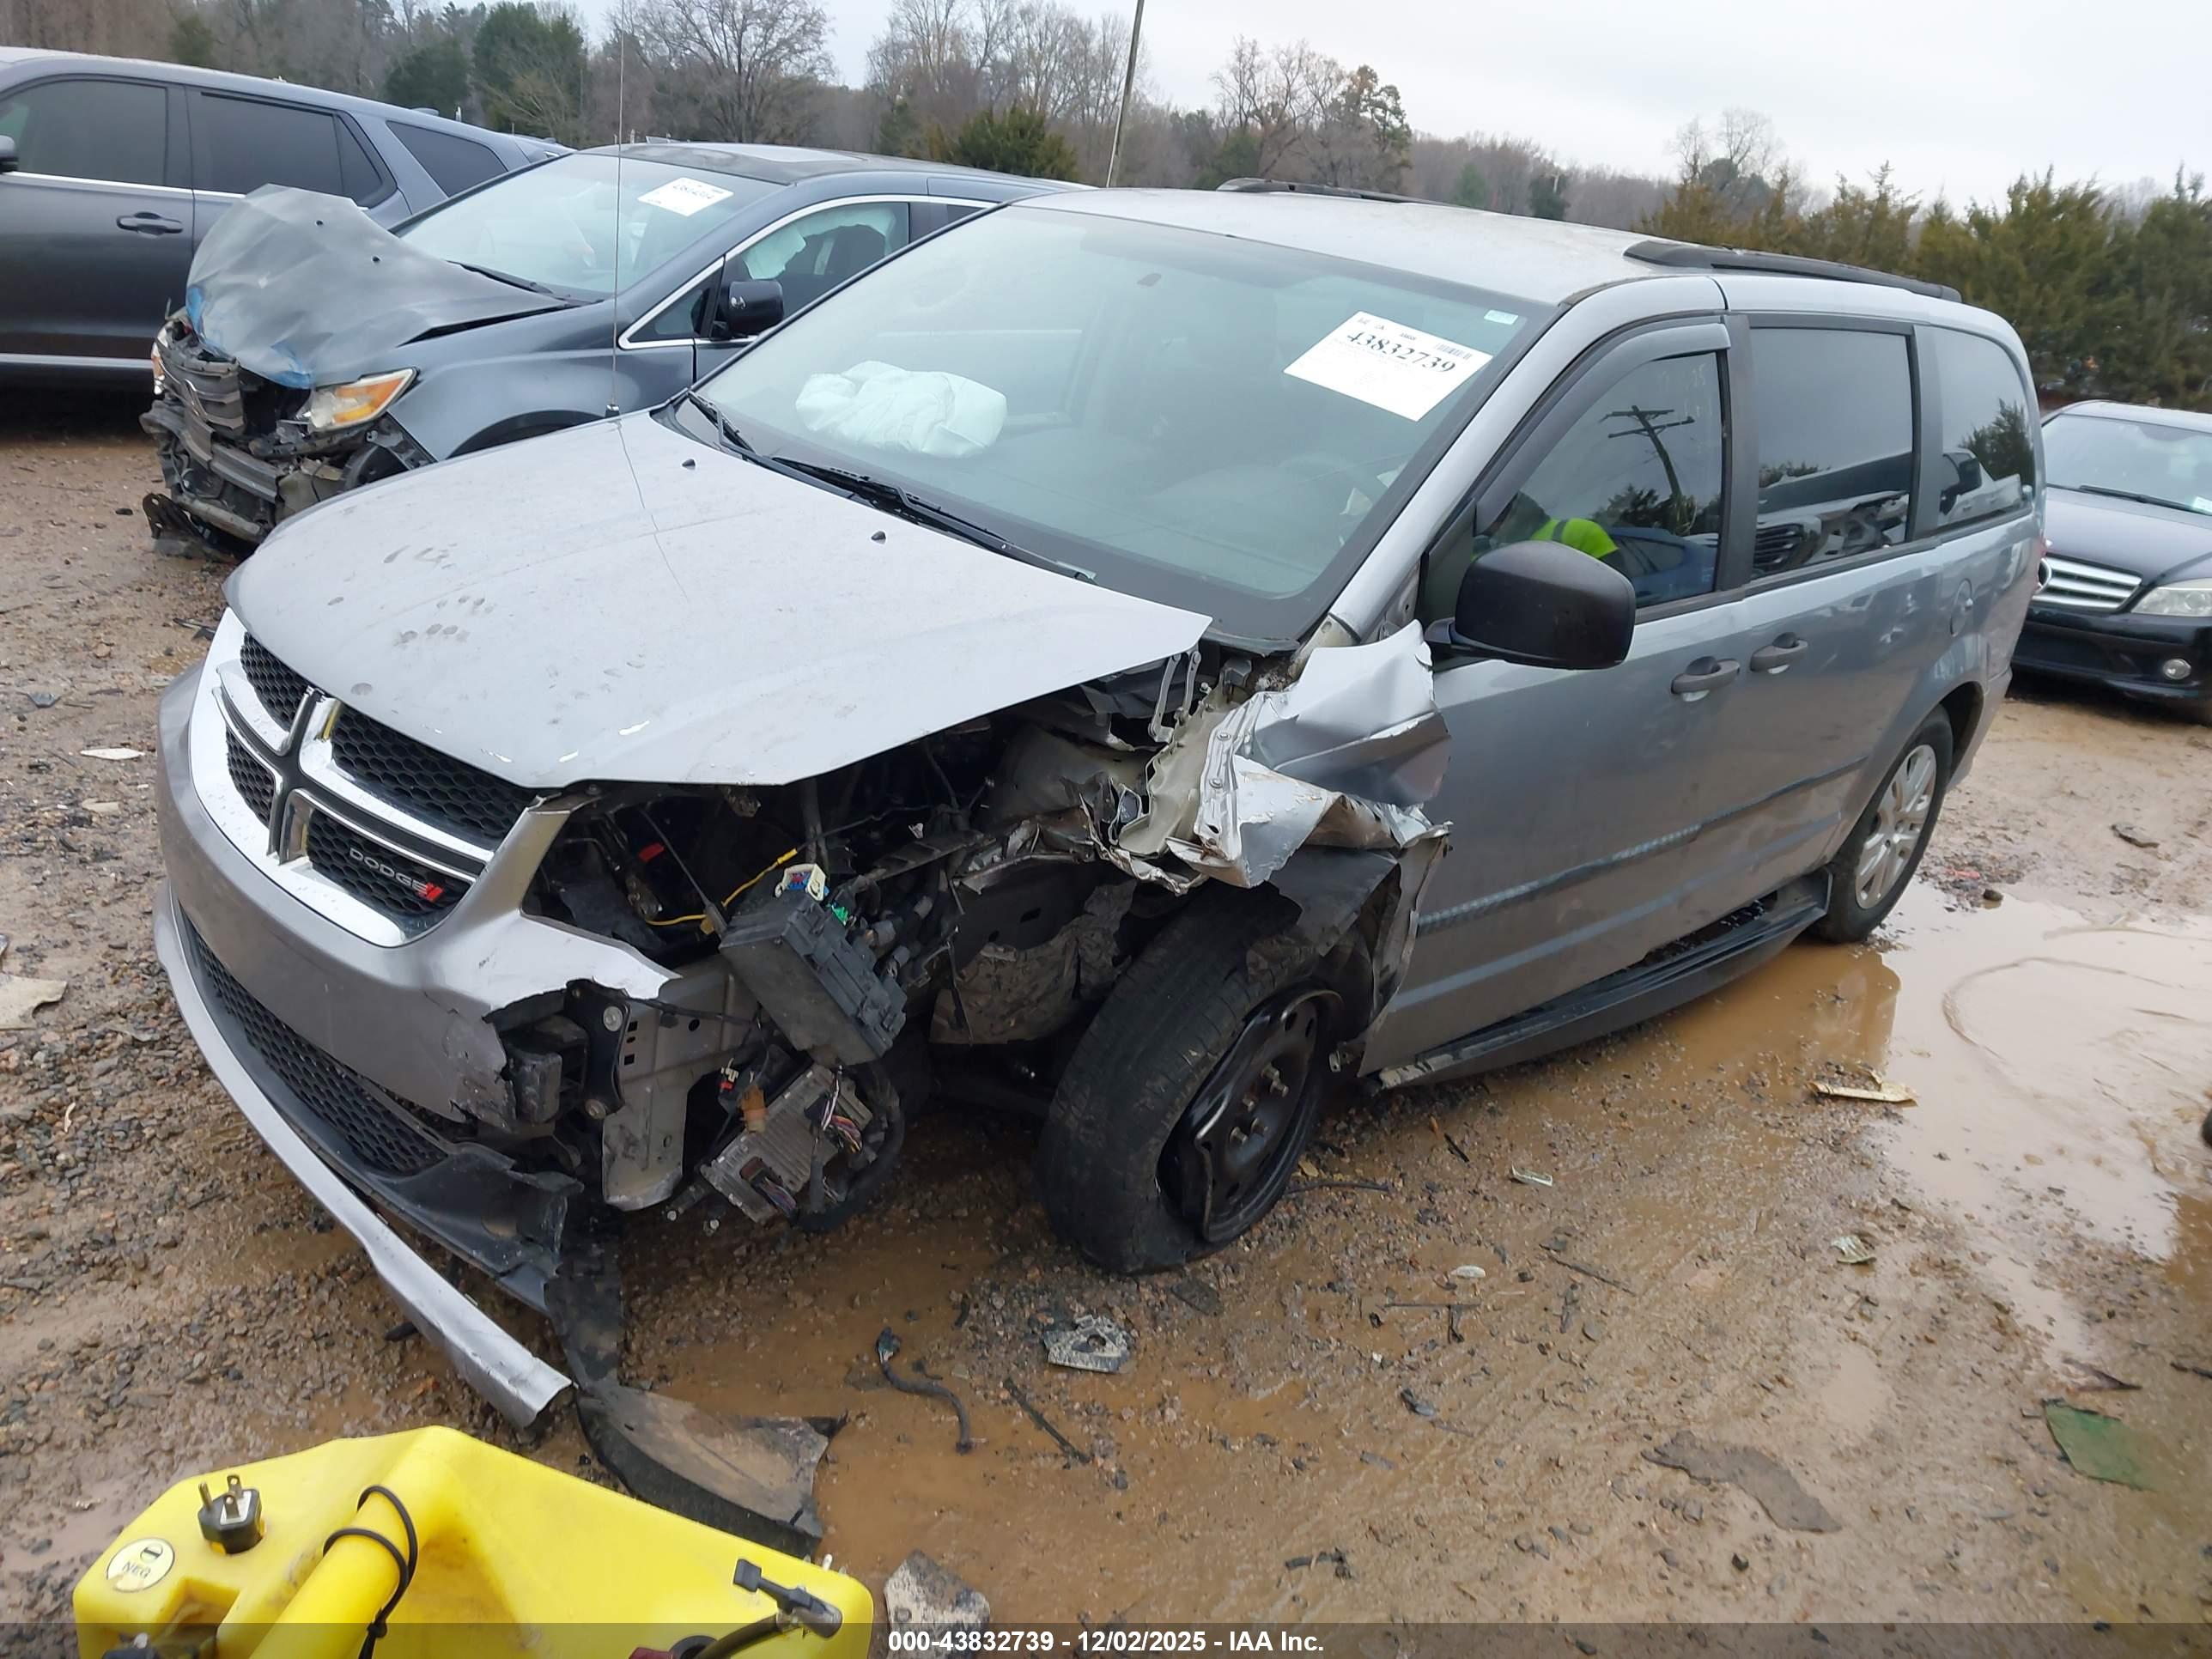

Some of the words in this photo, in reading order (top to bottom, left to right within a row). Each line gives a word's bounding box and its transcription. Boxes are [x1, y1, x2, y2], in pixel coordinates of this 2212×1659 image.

[1346, 331, 1456, 373] 43832739
[349, 847, 428, 895] DODGE
[122, 1561, 152, 1579] NEG
